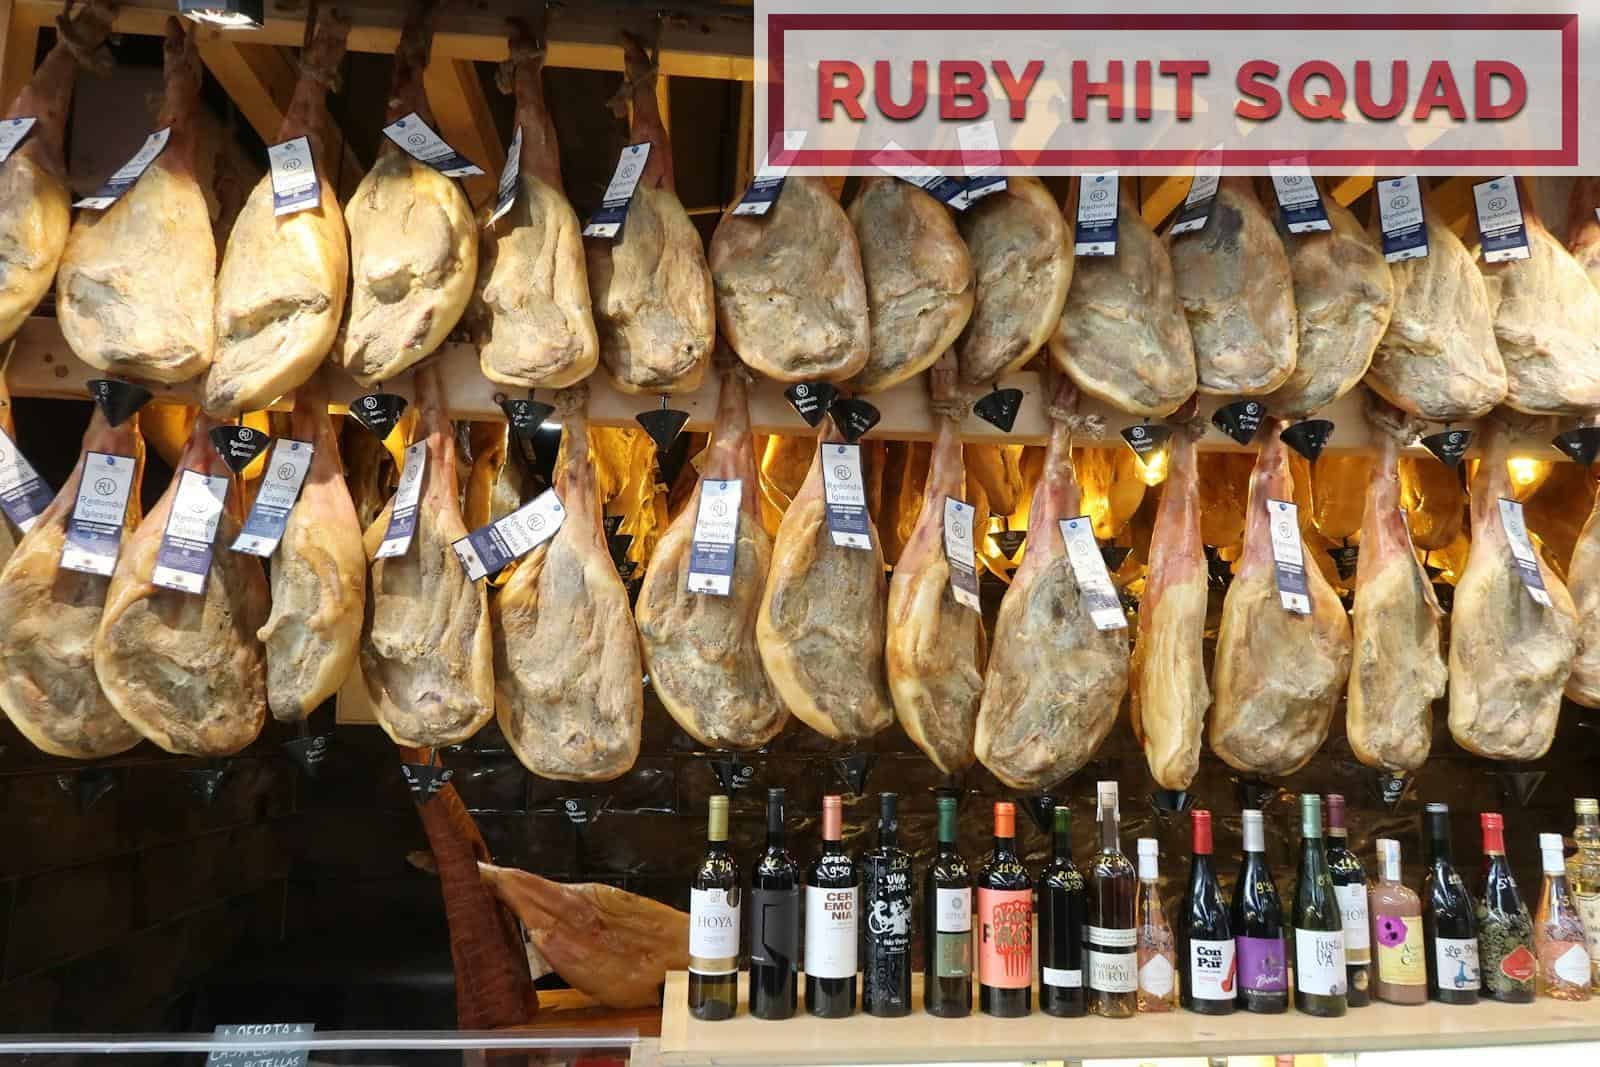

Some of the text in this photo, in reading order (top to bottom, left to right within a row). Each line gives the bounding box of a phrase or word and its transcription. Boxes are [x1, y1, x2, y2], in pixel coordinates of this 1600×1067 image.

[885, 871, 907, 885] UVA
[826, 892, 853, 902] CER
[824, 902, 853, 912] EMO
[831, 911, 853, 920] NIA
[698, 914, 733, 929] HOYA
[1197, 946, 1222, 957] Con
[1197, 957, 1222, 969] Par
